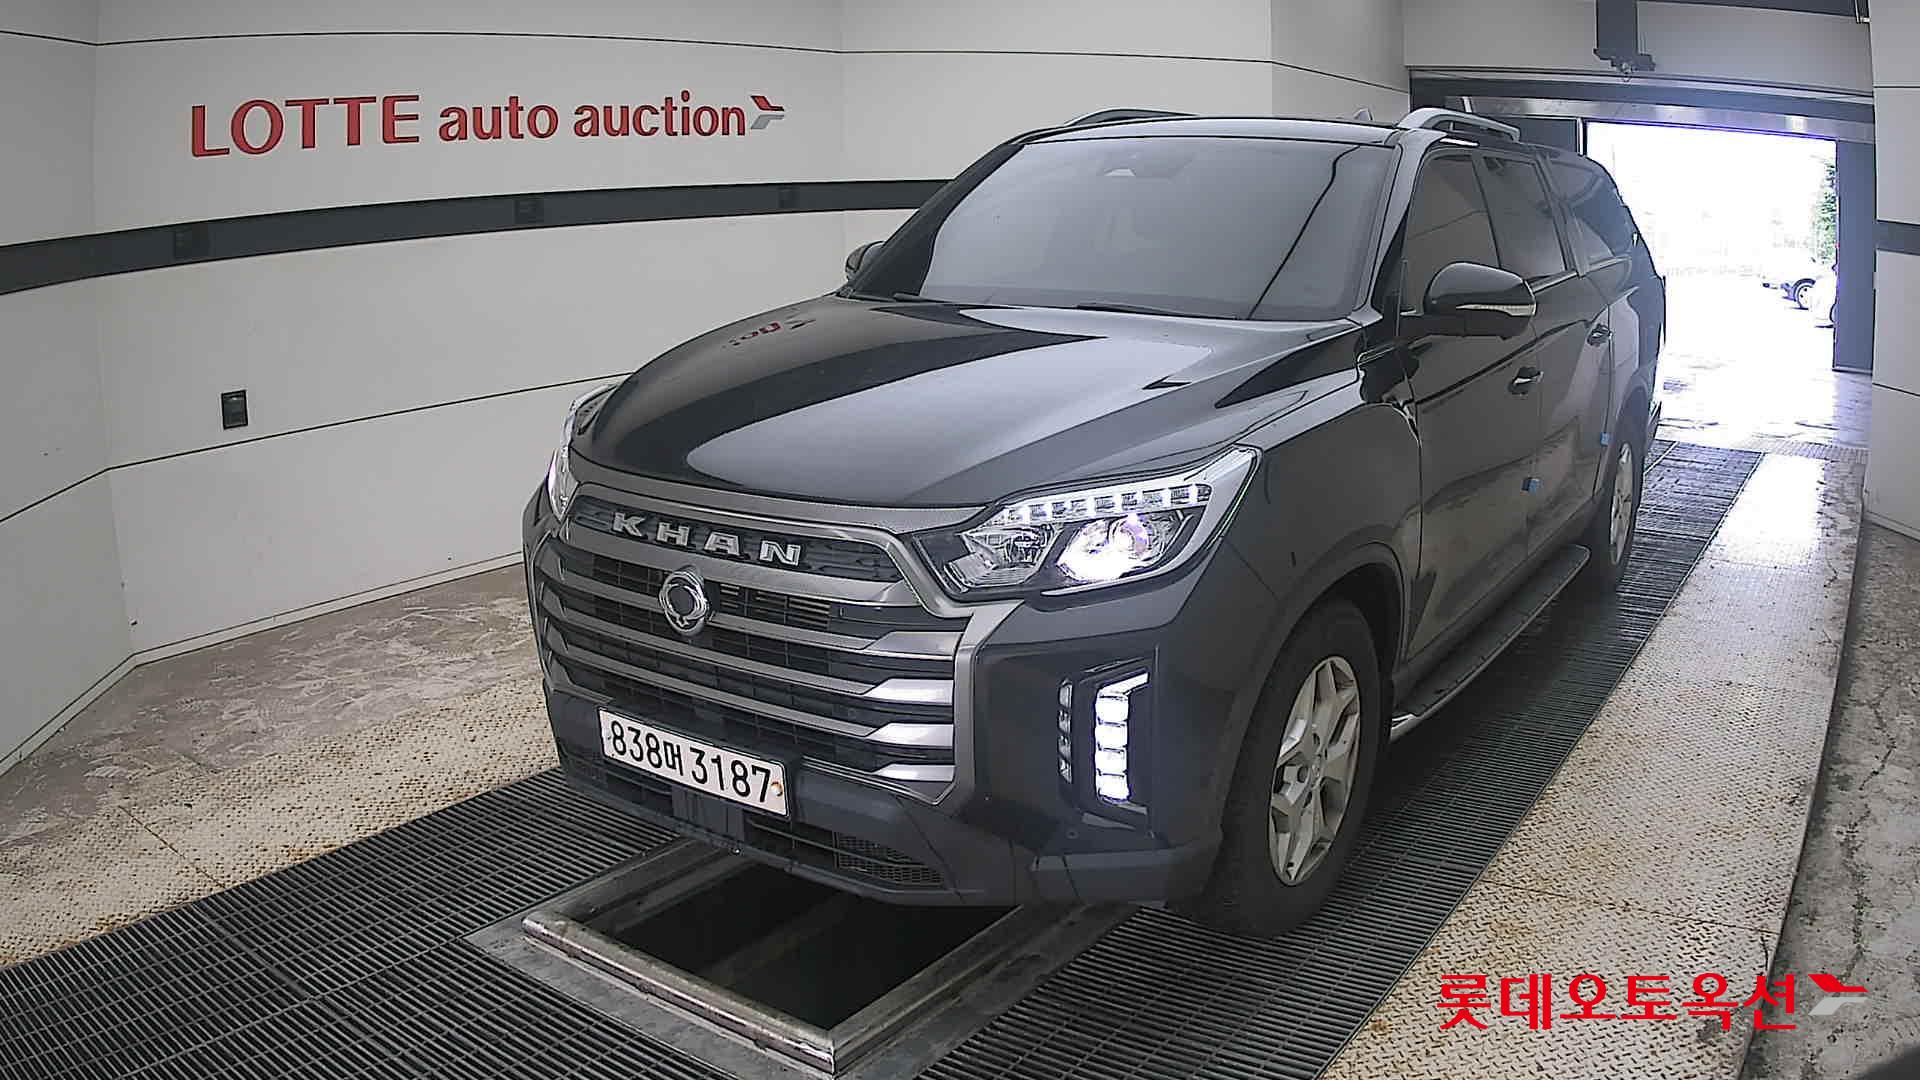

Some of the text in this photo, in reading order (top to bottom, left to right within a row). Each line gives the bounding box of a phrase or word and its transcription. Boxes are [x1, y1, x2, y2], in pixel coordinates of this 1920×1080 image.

[191, 90, 747, 158] LOTTE auto auction
[612, 511, 801, 567] KHAN
[610, 719, 771, 803] 838머 3187
